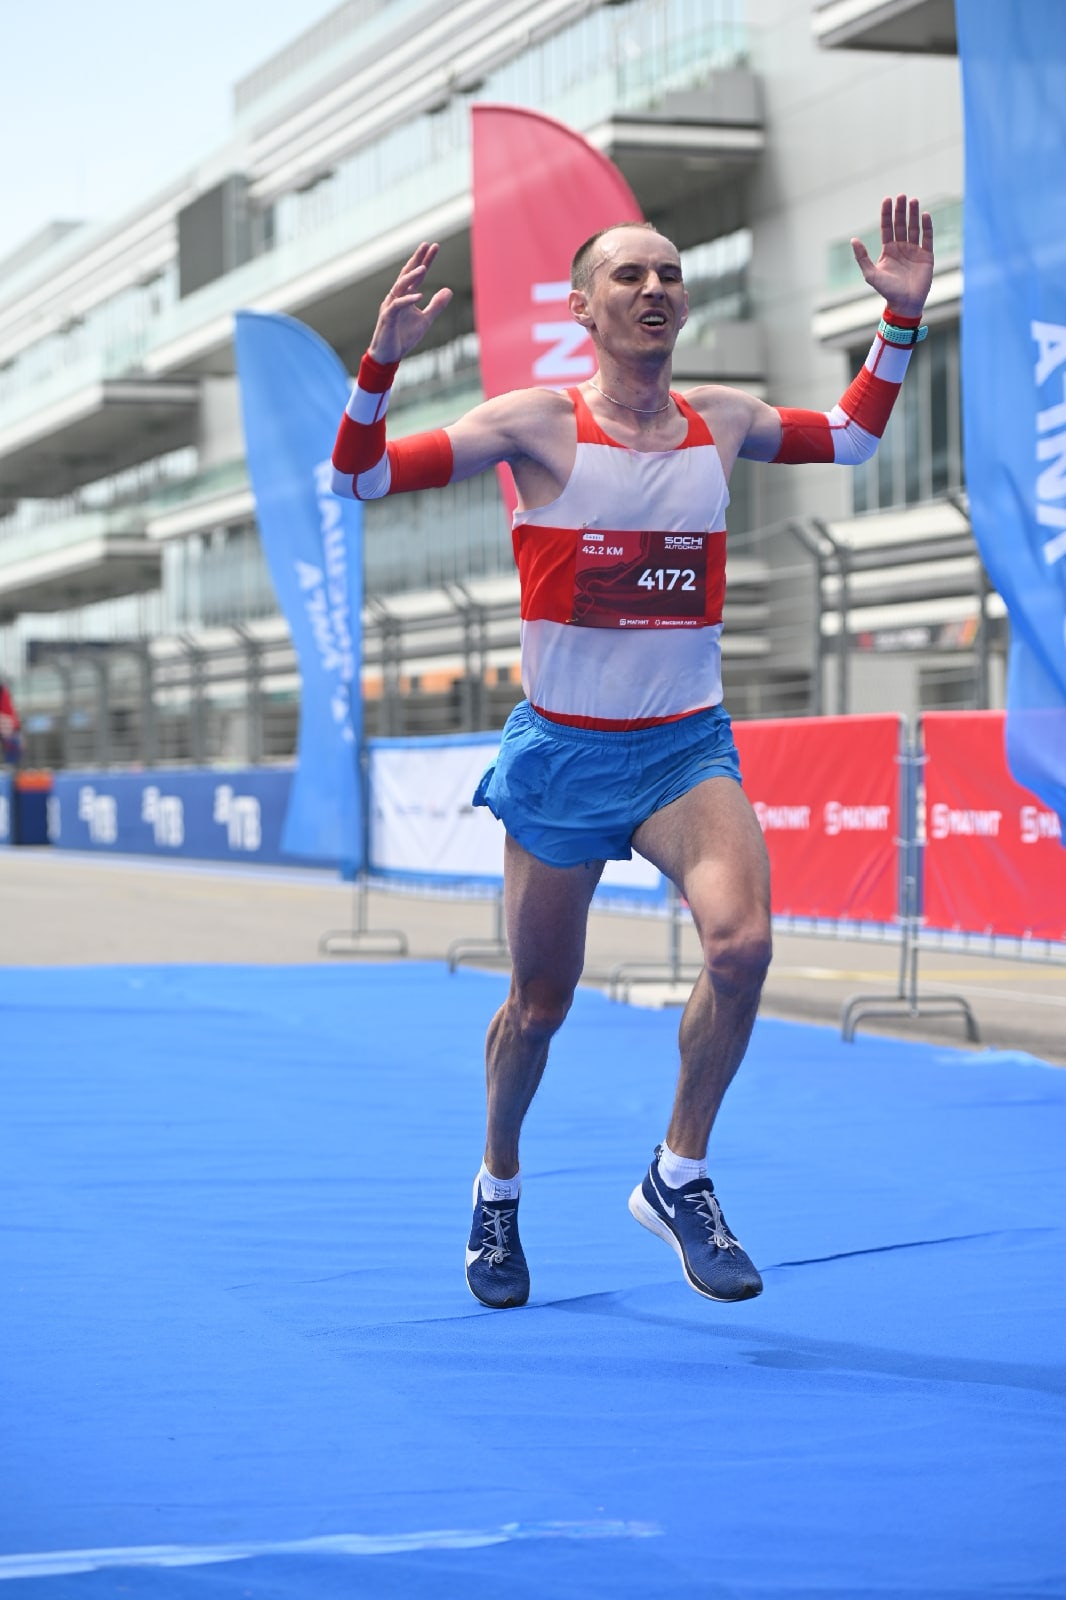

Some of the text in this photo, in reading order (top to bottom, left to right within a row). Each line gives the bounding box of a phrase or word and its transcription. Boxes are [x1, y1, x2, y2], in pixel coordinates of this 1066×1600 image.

[664, 536, 703, 545] SOCHI
[582, 545, 604, 555] 42.2
[637, 568, 697, 591] 4172
